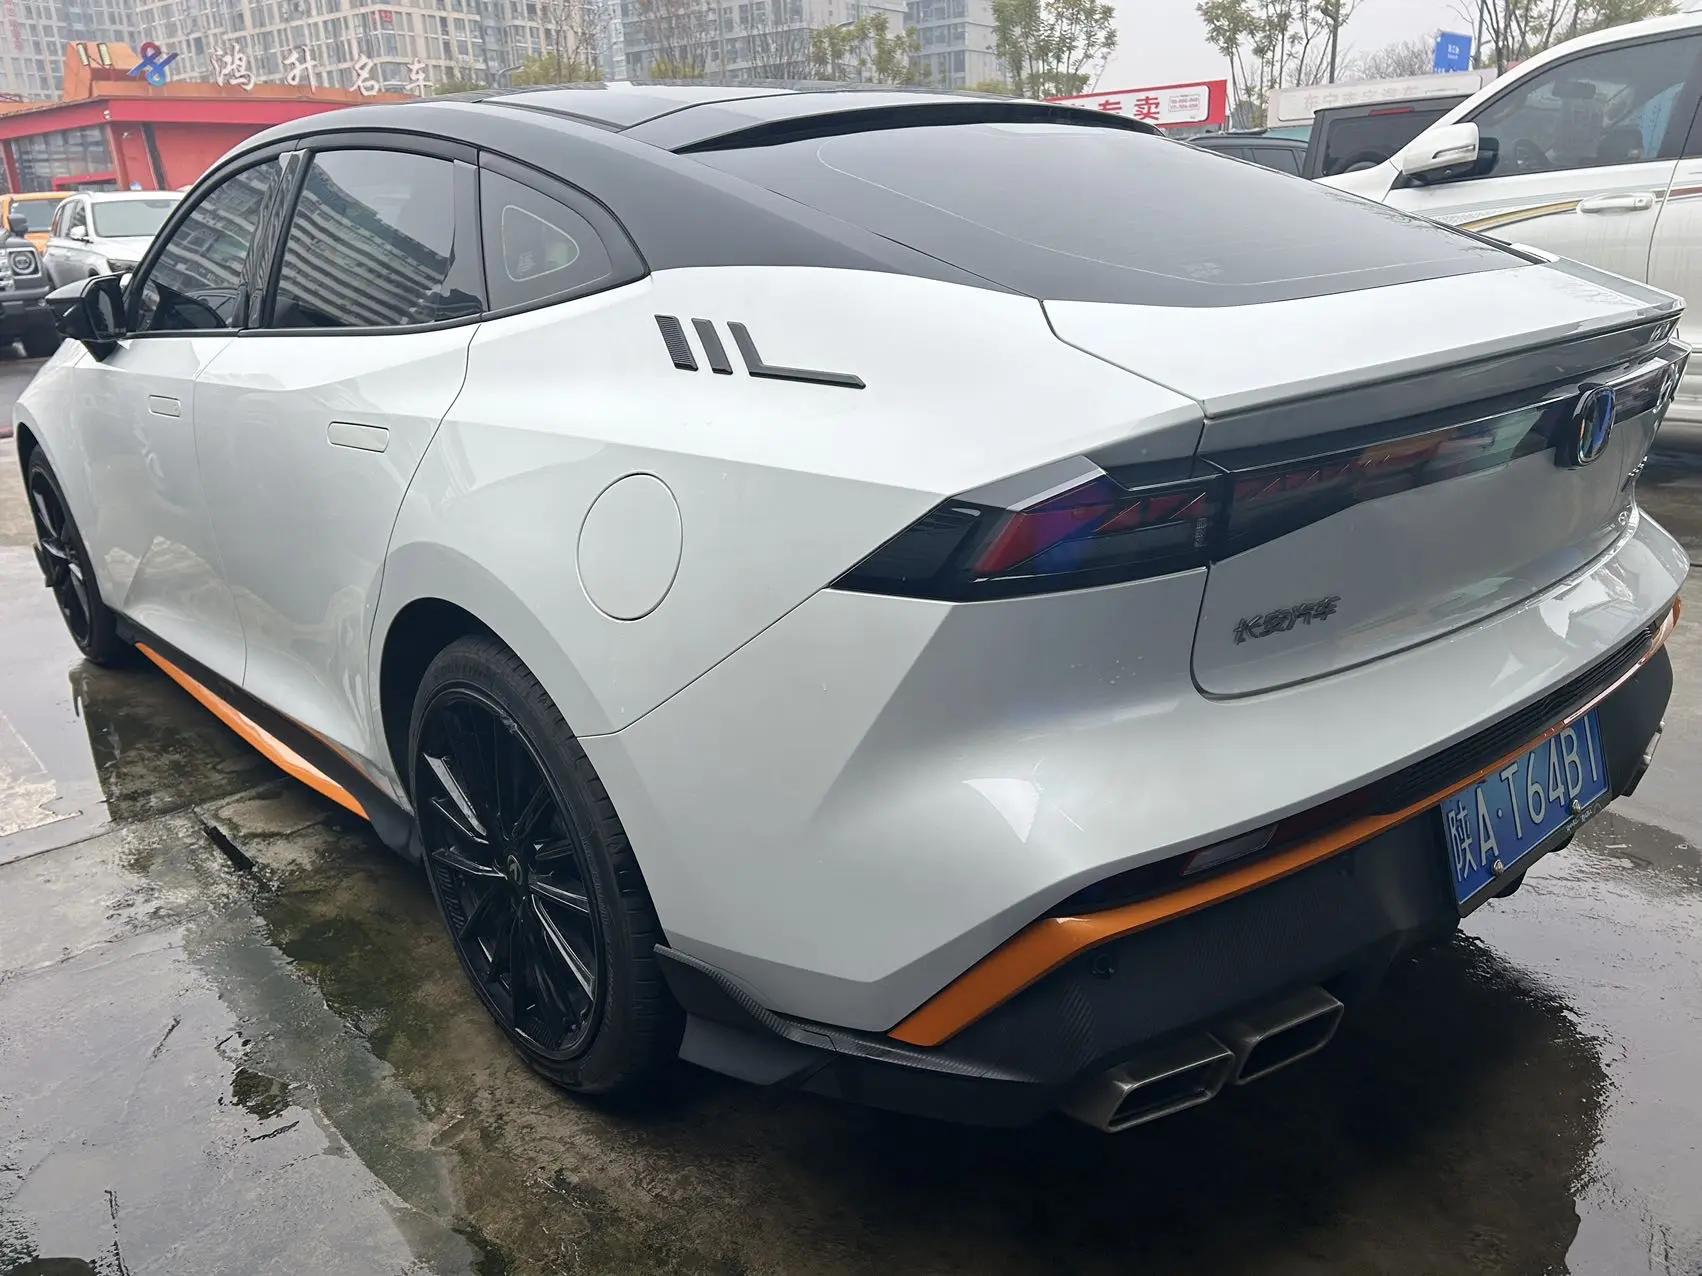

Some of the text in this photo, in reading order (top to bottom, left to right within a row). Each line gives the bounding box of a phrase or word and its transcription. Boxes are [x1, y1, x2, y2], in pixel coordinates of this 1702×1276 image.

[211, 43, 433, 98] 鸿升名车
[1233, 595, 1342, 645] 长安汽车
